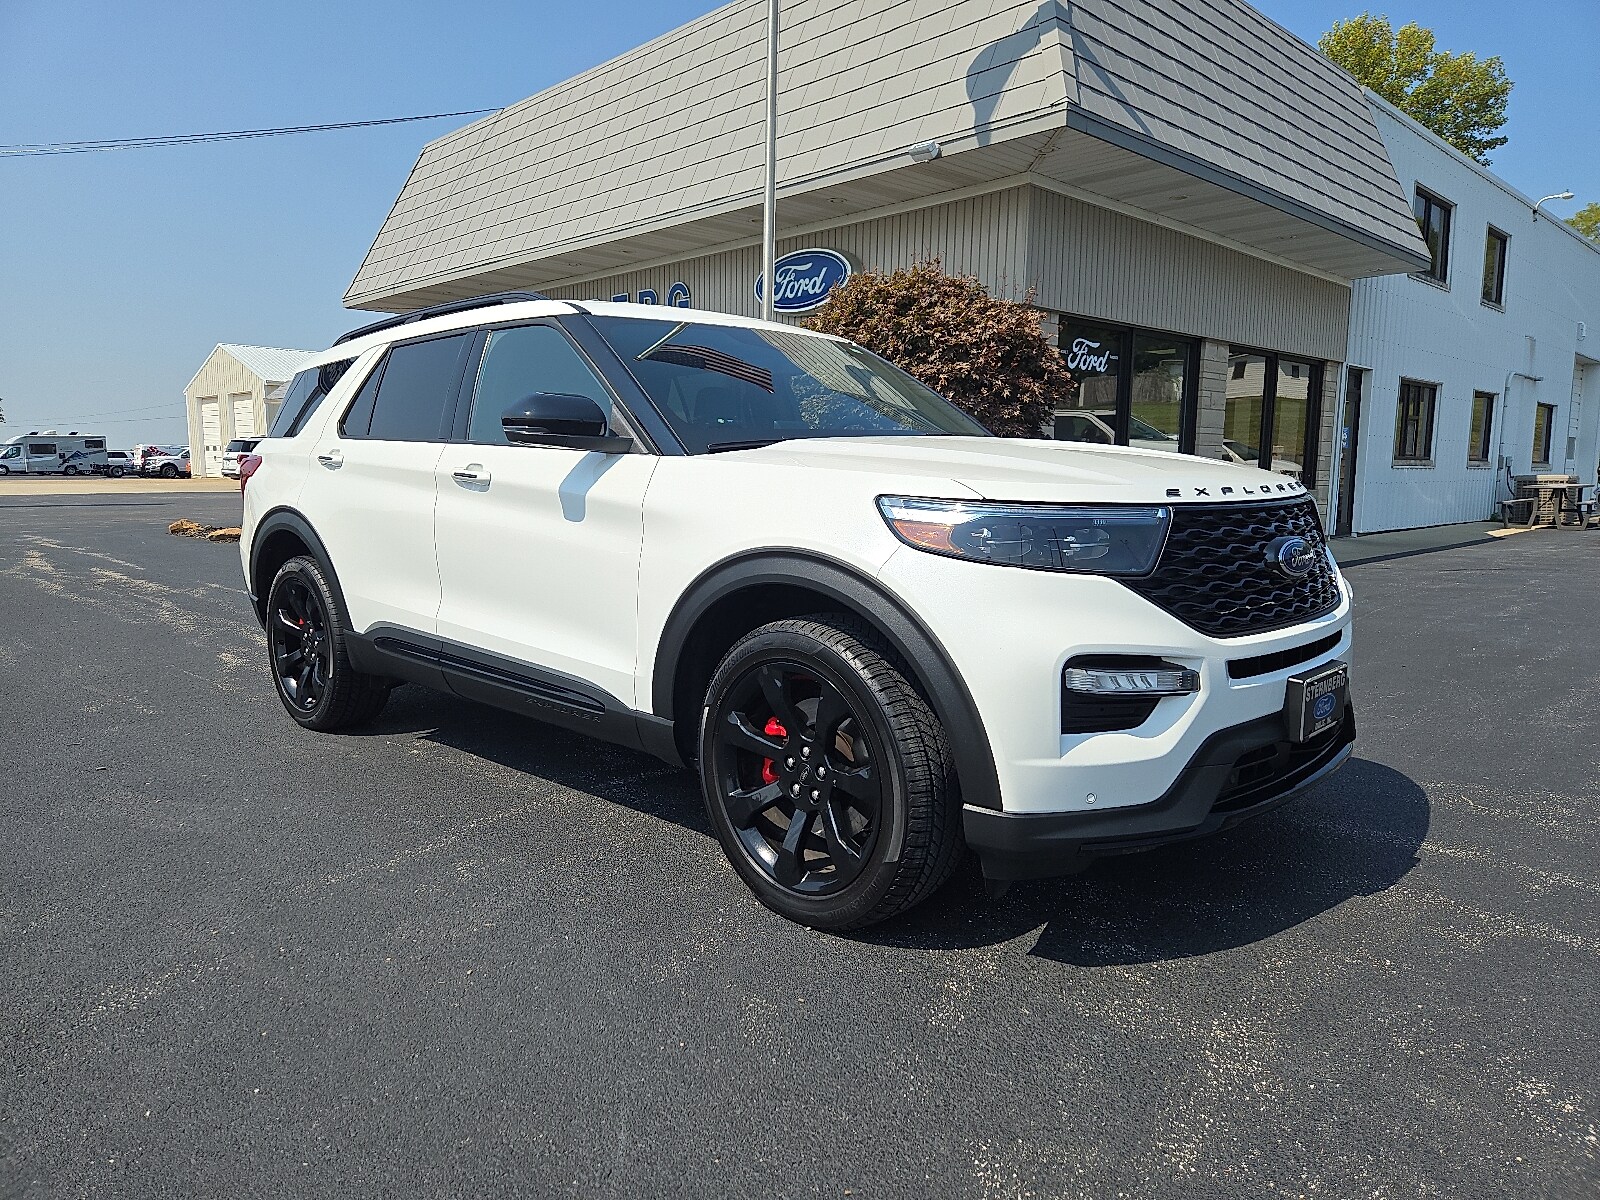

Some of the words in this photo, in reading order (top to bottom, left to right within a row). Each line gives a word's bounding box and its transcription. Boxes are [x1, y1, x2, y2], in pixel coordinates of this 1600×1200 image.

[774, 262, 828, 301] Ford
[1067, 337, 1110, 372] Ford
[1291, 546, 1316, 567] Ford
[1305, 671, 1346, 703] STERNBERG
